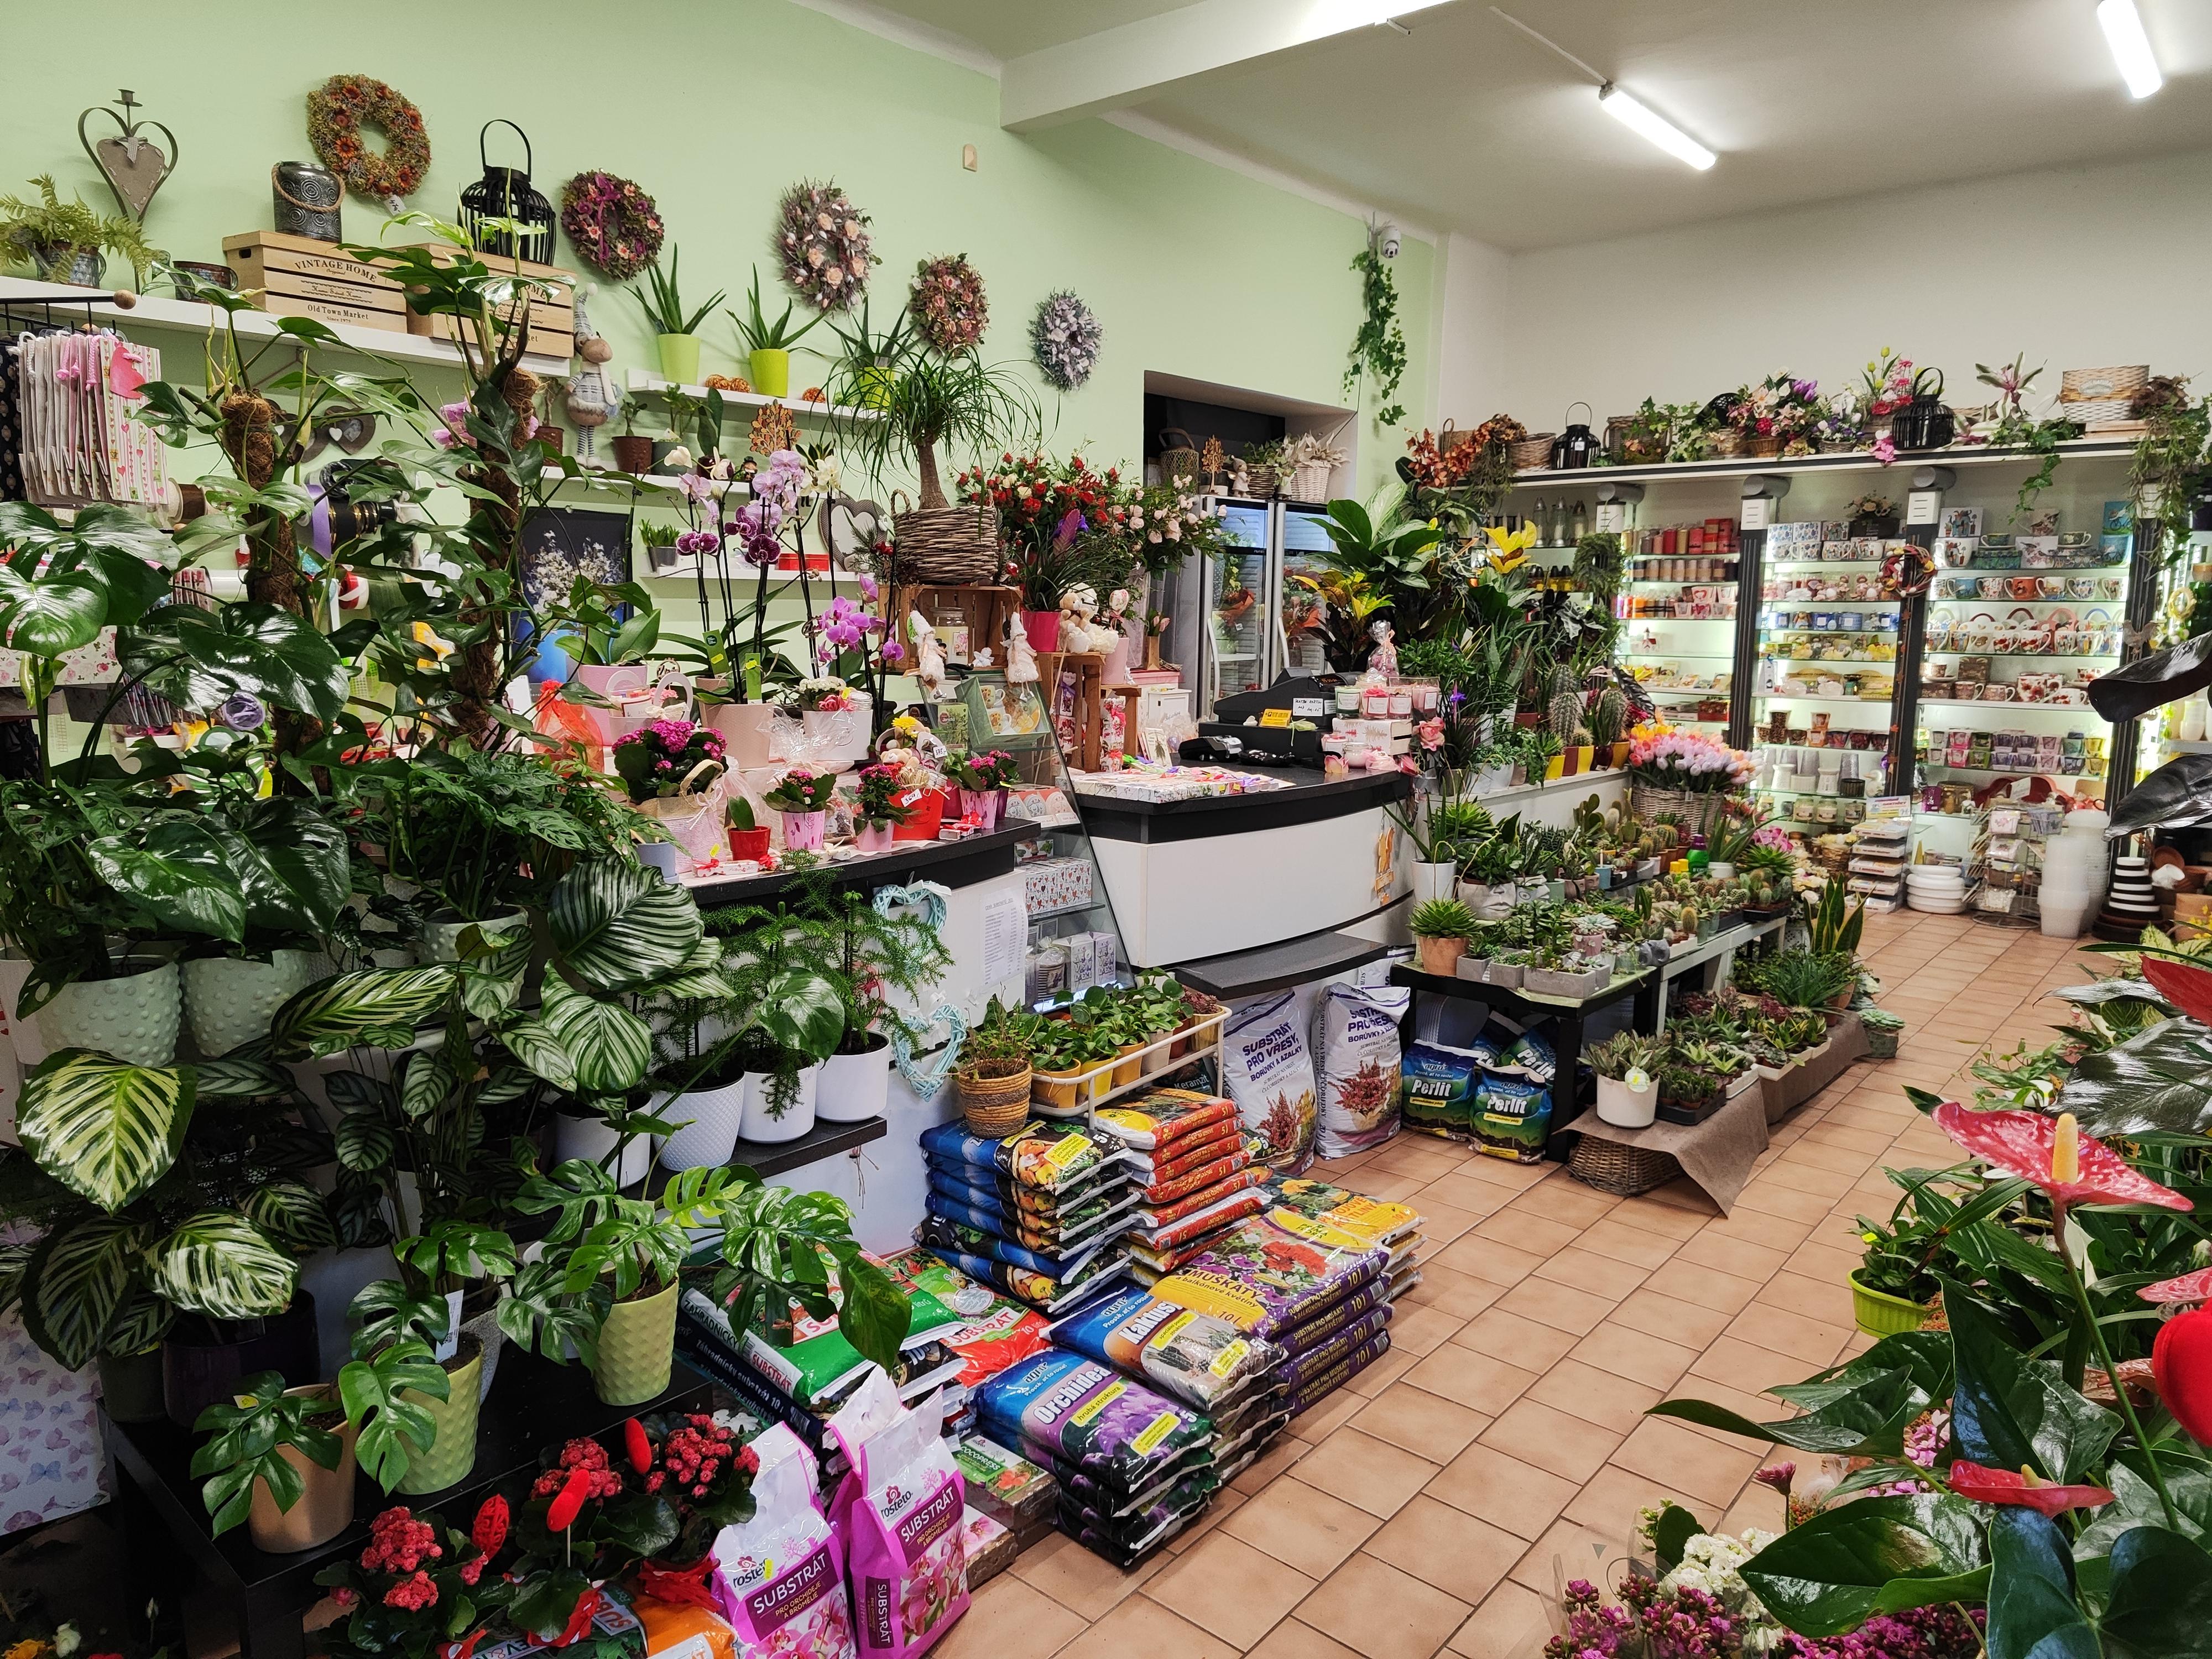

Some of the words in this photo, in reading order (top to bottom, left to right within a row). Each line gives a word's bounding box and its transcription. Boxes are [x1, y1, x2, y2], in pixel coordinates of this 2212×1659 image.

[295, 259, 343, 270] VINTAGE
[346, 263, 377, 283] HOME
[307, 304, 320, 312] Old
[322, 306, 341, 316] Town
[343, 310, 369, 320] Market
[1242, 1021, 1292, 1056] SUBSTRÁT
[1246, 1052, 1265, 1071] PRO
[1266, 1032, 1300, 1058] VŘESY,
[1250, 1061, 1275, 1082] BORŮVKY
[1280, 1045, 1302, 1062] AZALKY
[1174, 1074, 1209, 1089] Keramzit
[1412, 1079, 1451, 1097] Perlit
[1487, 1095, 1527, 1114] Perlit
[1225, 1290, 1258, 1308] květiny
[1218, 1311, 1234, 1322] 10
[1293, 1322, 1316, 1340] SUBSTRÁT
[1297, 1356, 1319, 1373] SUBSTRÁT
[1319, 1351, 1329, 1361] PRO
[1328, 1337, 1348, 1355] MUŠKÁTY
[752, 1354, 792, 1392] SUBSTRÁT
[1297, 1379, 1319, 1398] SUBSTRÁT
[1319, 1374, 1329, 1386] PRO
[1328, 1358, 1350, 1379] MUŠKÁTY
[738, 1372, 770, 1402] substrát
[771, 1396, 780, 1409] 10
[1033, 1365, 1112, 1425] Orchidea
[1077, 1404, 1097, 1421] hrubá
[1095, 1385, 1121, 1406] struktura
[960, 1446, 1000, 1470] COCOPRESS
[880, 1491, 912, 1519] rosteto
[901, 1486, 954, 1542] SUBSTRÁT
[917, 1535, 925, 1545] PRO
[925, 1512, 951, 1536] ORCHIDEJE
[926, 1522, 948, 1545] BROMÉLIE
[754, 1552, 826, 1614] SUBSTRÁT
[775, 1604, 789, 1616] PRO
[790, 1580, 822, 1607] ORCHIDEJE
[789, 1592, 819, 1615] BROMÉLIE
[878, 1584, 890, 1644] SUBSTRÁT
[940, 1607, 953, 1624] litry
